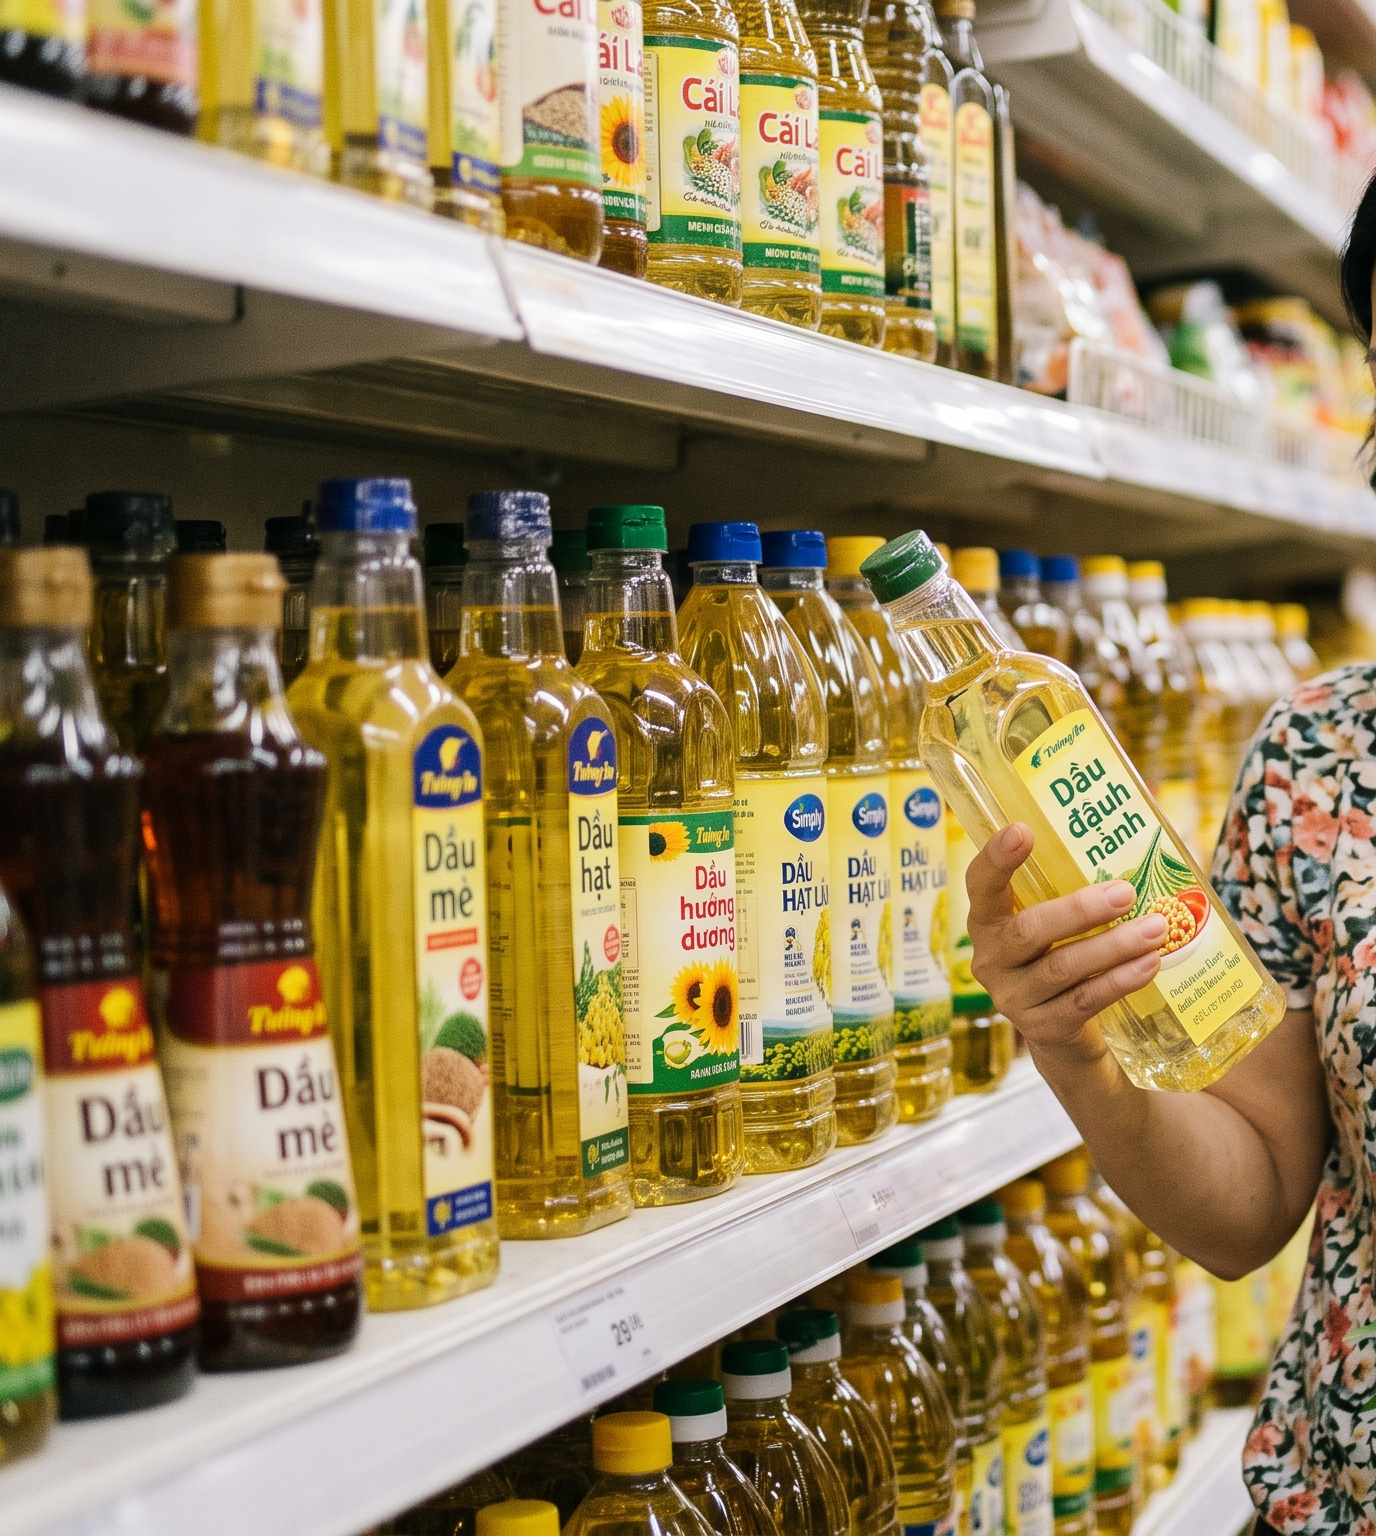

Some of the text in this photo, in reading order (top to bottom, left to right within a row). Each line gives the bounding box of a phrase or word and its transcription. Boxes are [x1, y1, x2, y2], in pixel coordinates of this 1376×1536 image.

[1049, 757, 1107, 808] Dầu
[578, 809, 613, 852] Dầu
[792, 804, 823, 832] Simply
[581, 856, 612, 901] hạt
[782, 886, 812, 916] HẠT
[848, 880, 876, 908] HẠT
[681, 925, 735, 952] dương
